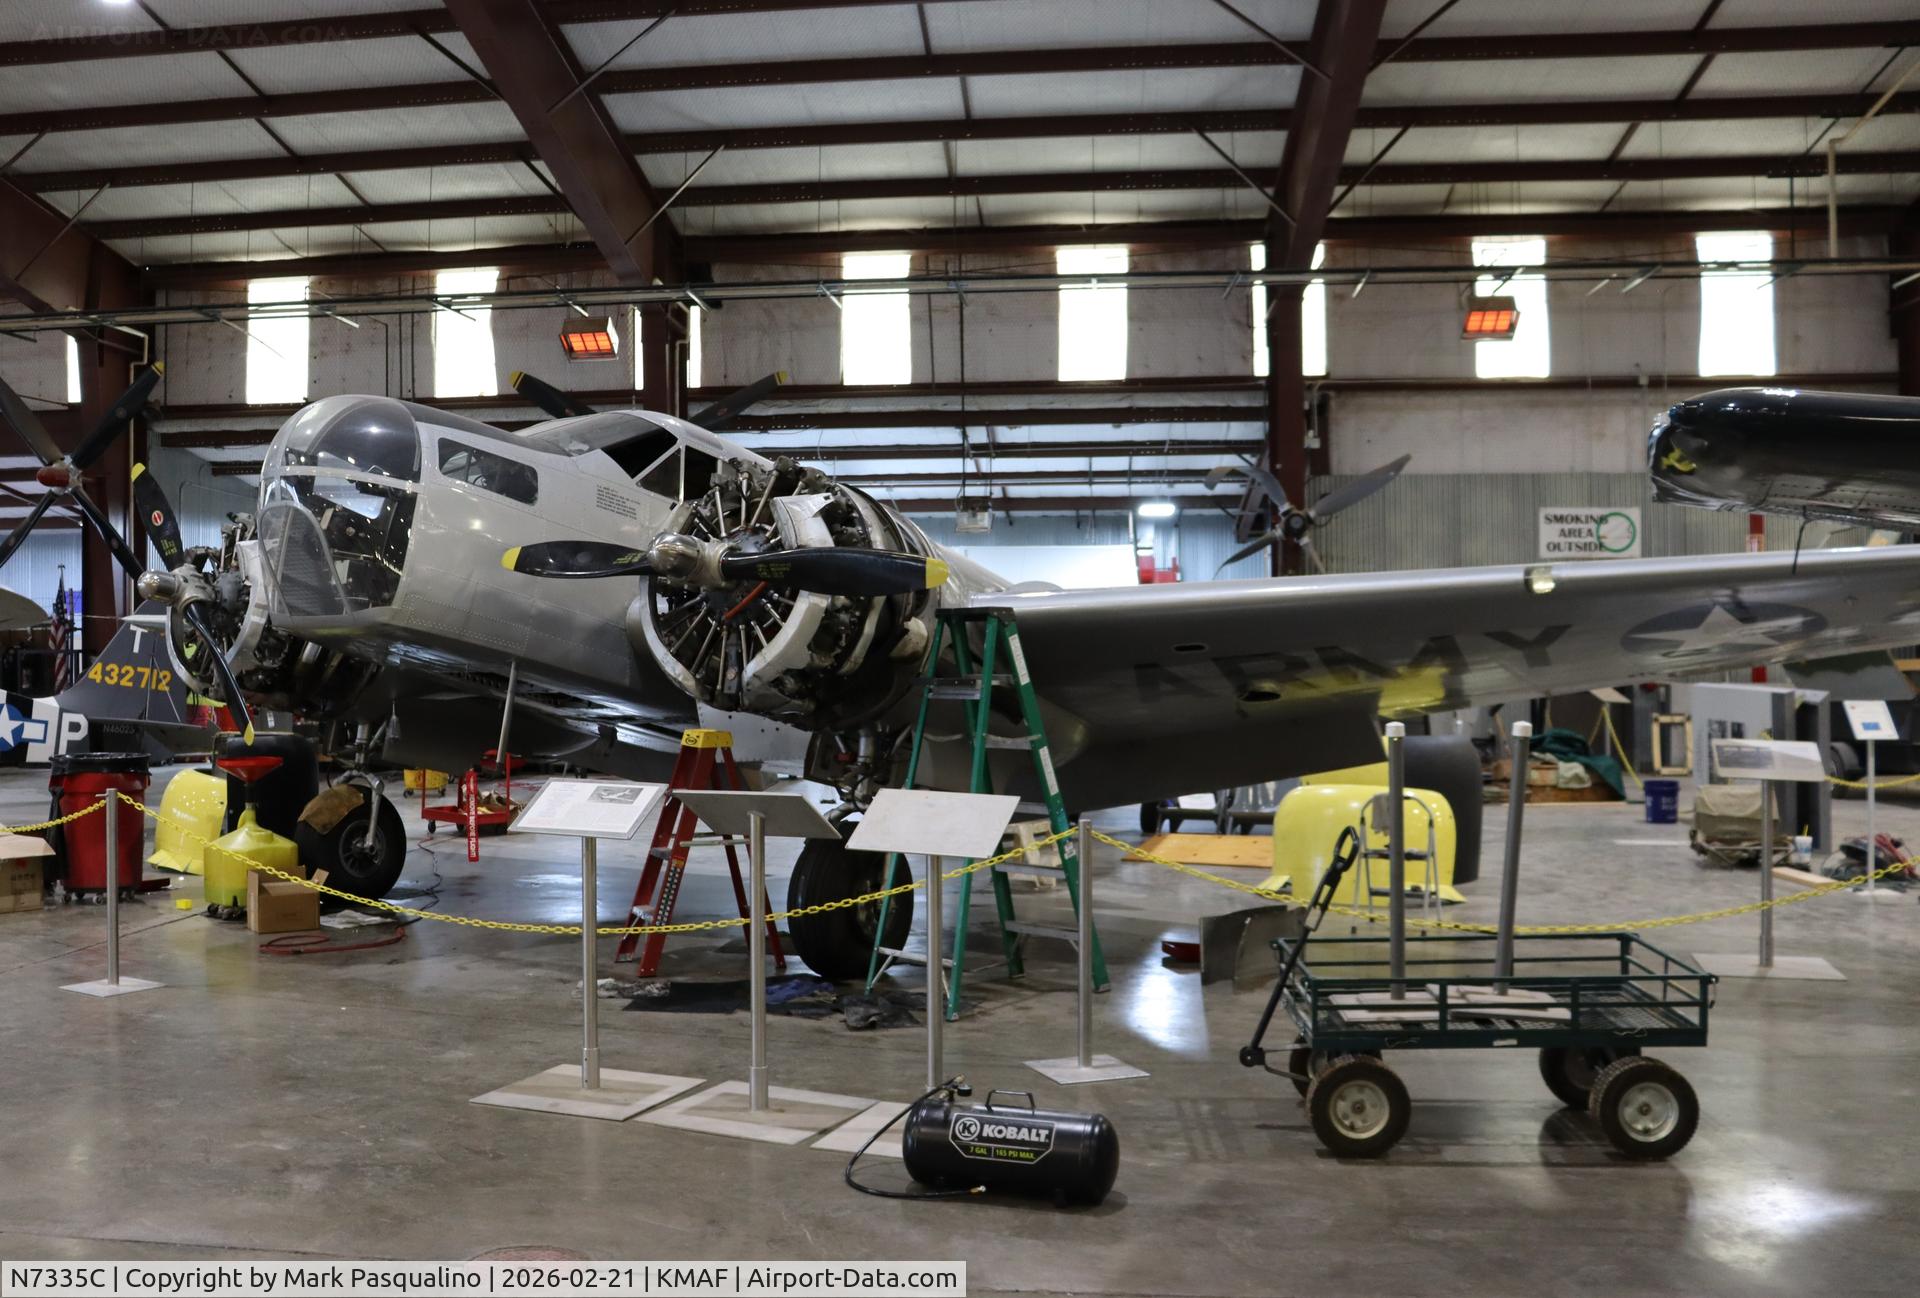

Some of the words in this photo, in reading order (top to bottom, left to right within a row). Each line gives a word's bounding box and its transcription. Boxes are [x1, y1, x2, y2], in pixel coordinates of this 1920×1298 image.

[1559, 528, 1594, 538] AREA
[130, 624, 148, 653] T
[88, 662, 172, 691] 432712
[58, 712, 88, 755] P
[982, 1124, 1049, 1142] KOBALT
[975, 1147, 988, 1155] GAL
[996, 1148, 1008, 1156] 165
[1009, 1150, 1019, 1158] PSI
